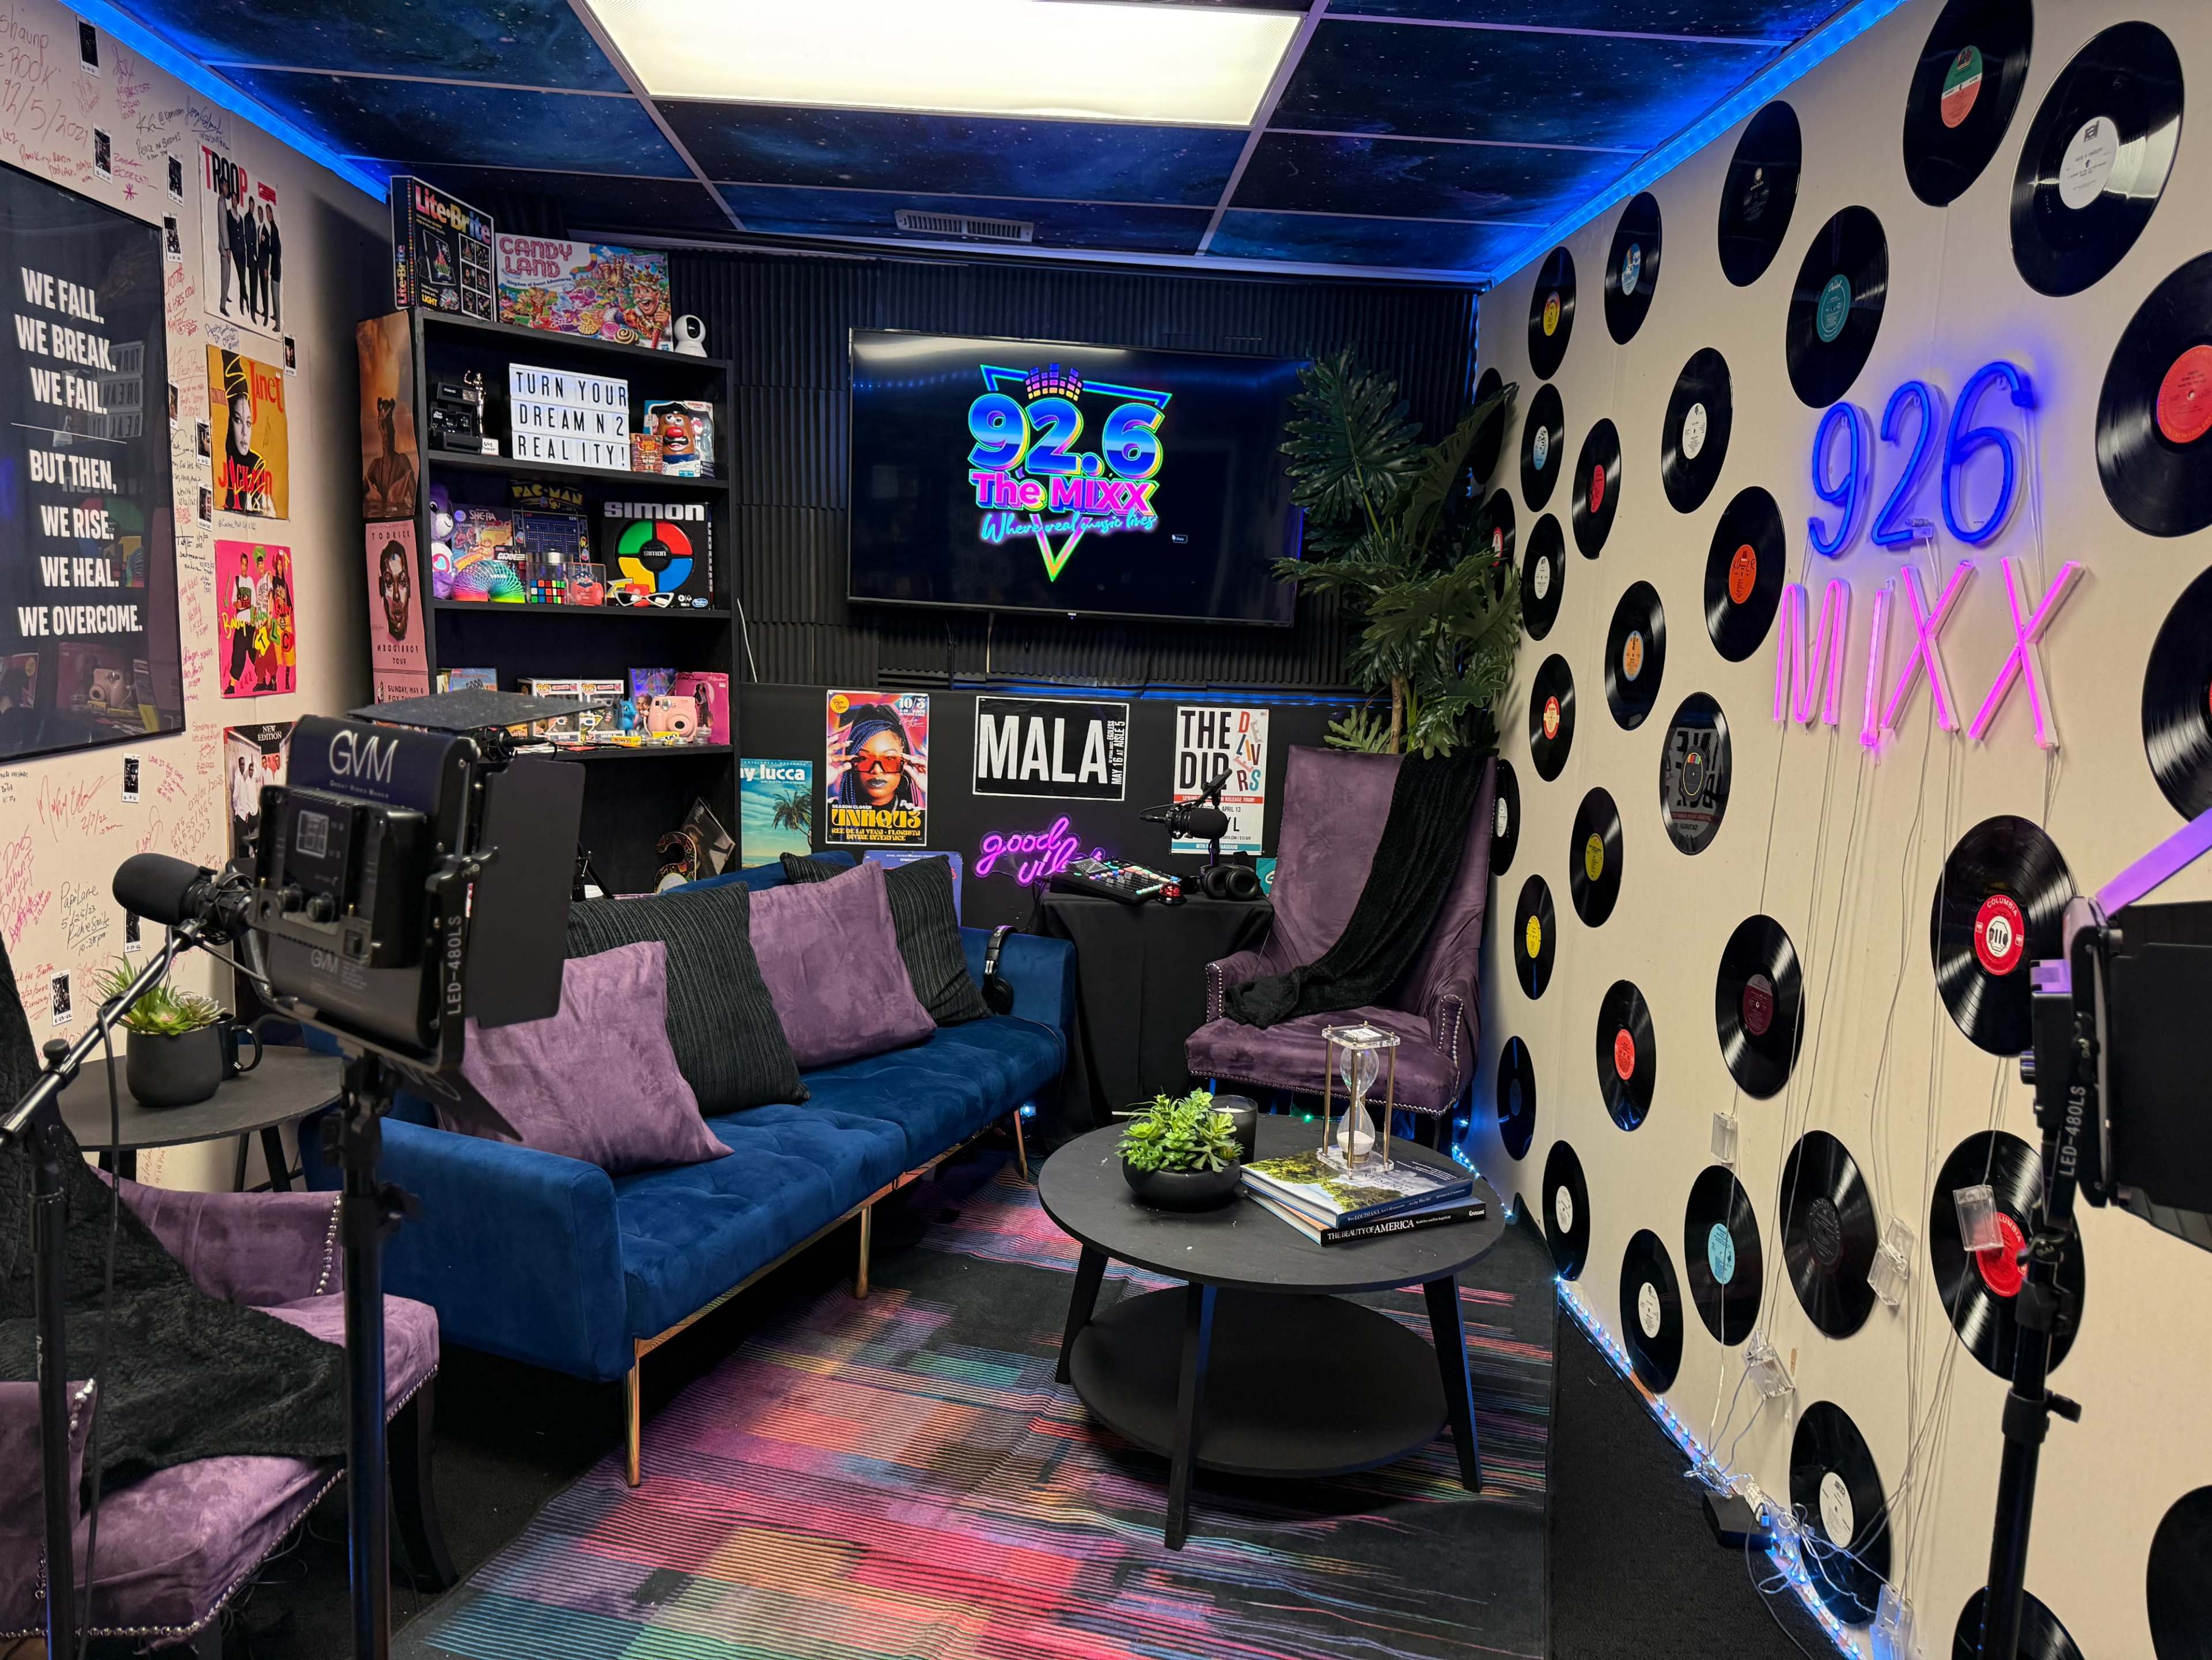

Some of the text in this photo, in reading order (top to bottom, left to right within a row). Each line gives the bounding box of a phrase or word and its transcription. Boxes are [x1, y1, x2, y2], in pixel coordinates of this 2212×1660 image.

[202, 145, 248, 208] TROOP
[499, 236, 573, 262] CANDY
[505, 255, 560, 278] LAND
[21, 267, 104, 324] WE FALL.
[14, 314, 116, 372] WE BREAK.
[30, 367, 108, 415] WE FAIL.
[516, 372, 627, 407] TURN YOUR
[520, 403, 624, 437] DREAM N 2
[969, 392, 1165, 479] 92.6
[29, 449, 117, 494] BUT THEN,
[1808, 361, 2035, 557] 926
[969, 469, 1047, 511] The
[41, 505, 114, 540] WE RISE.
[981, 508, 1157, 543] Where real music lives
[40, 557, 119, 587] WE HEAL.
[18, 605, 143, 637] WE OVERCOME.
[1773, 557, 2085, 751] MIXX
[388, 685, 408, 694] SUNDAY,
[409, 686, 419, 694] MAY
[258, 732, 282, 741] EDITION
[262, 725, 276, 733] NEW
[1113, 728, 1125, 747] AISLE
[1180, 710, 1232, 750] THE
[329, 729, 399, 784] GVM
[978, 713, 1108, 784] MALA
[1112, 757, 1124, 766] 16
[760, 764, 805, 781] lucca
[1111, 769, 1123, 785] MAY
[975, 816, 1072, 877] good
[1987, 897, 2018, 917] COLUMBIA
[448, 916, 461, 1016] LED-480LS
[2059, 1086, 2086, 1177] LED-480LS
[1327, 1219, 1415, 1241] THE BEAUTY OF AMERICA
[1354, 1209, 1380, 1220] LOUISIANA
